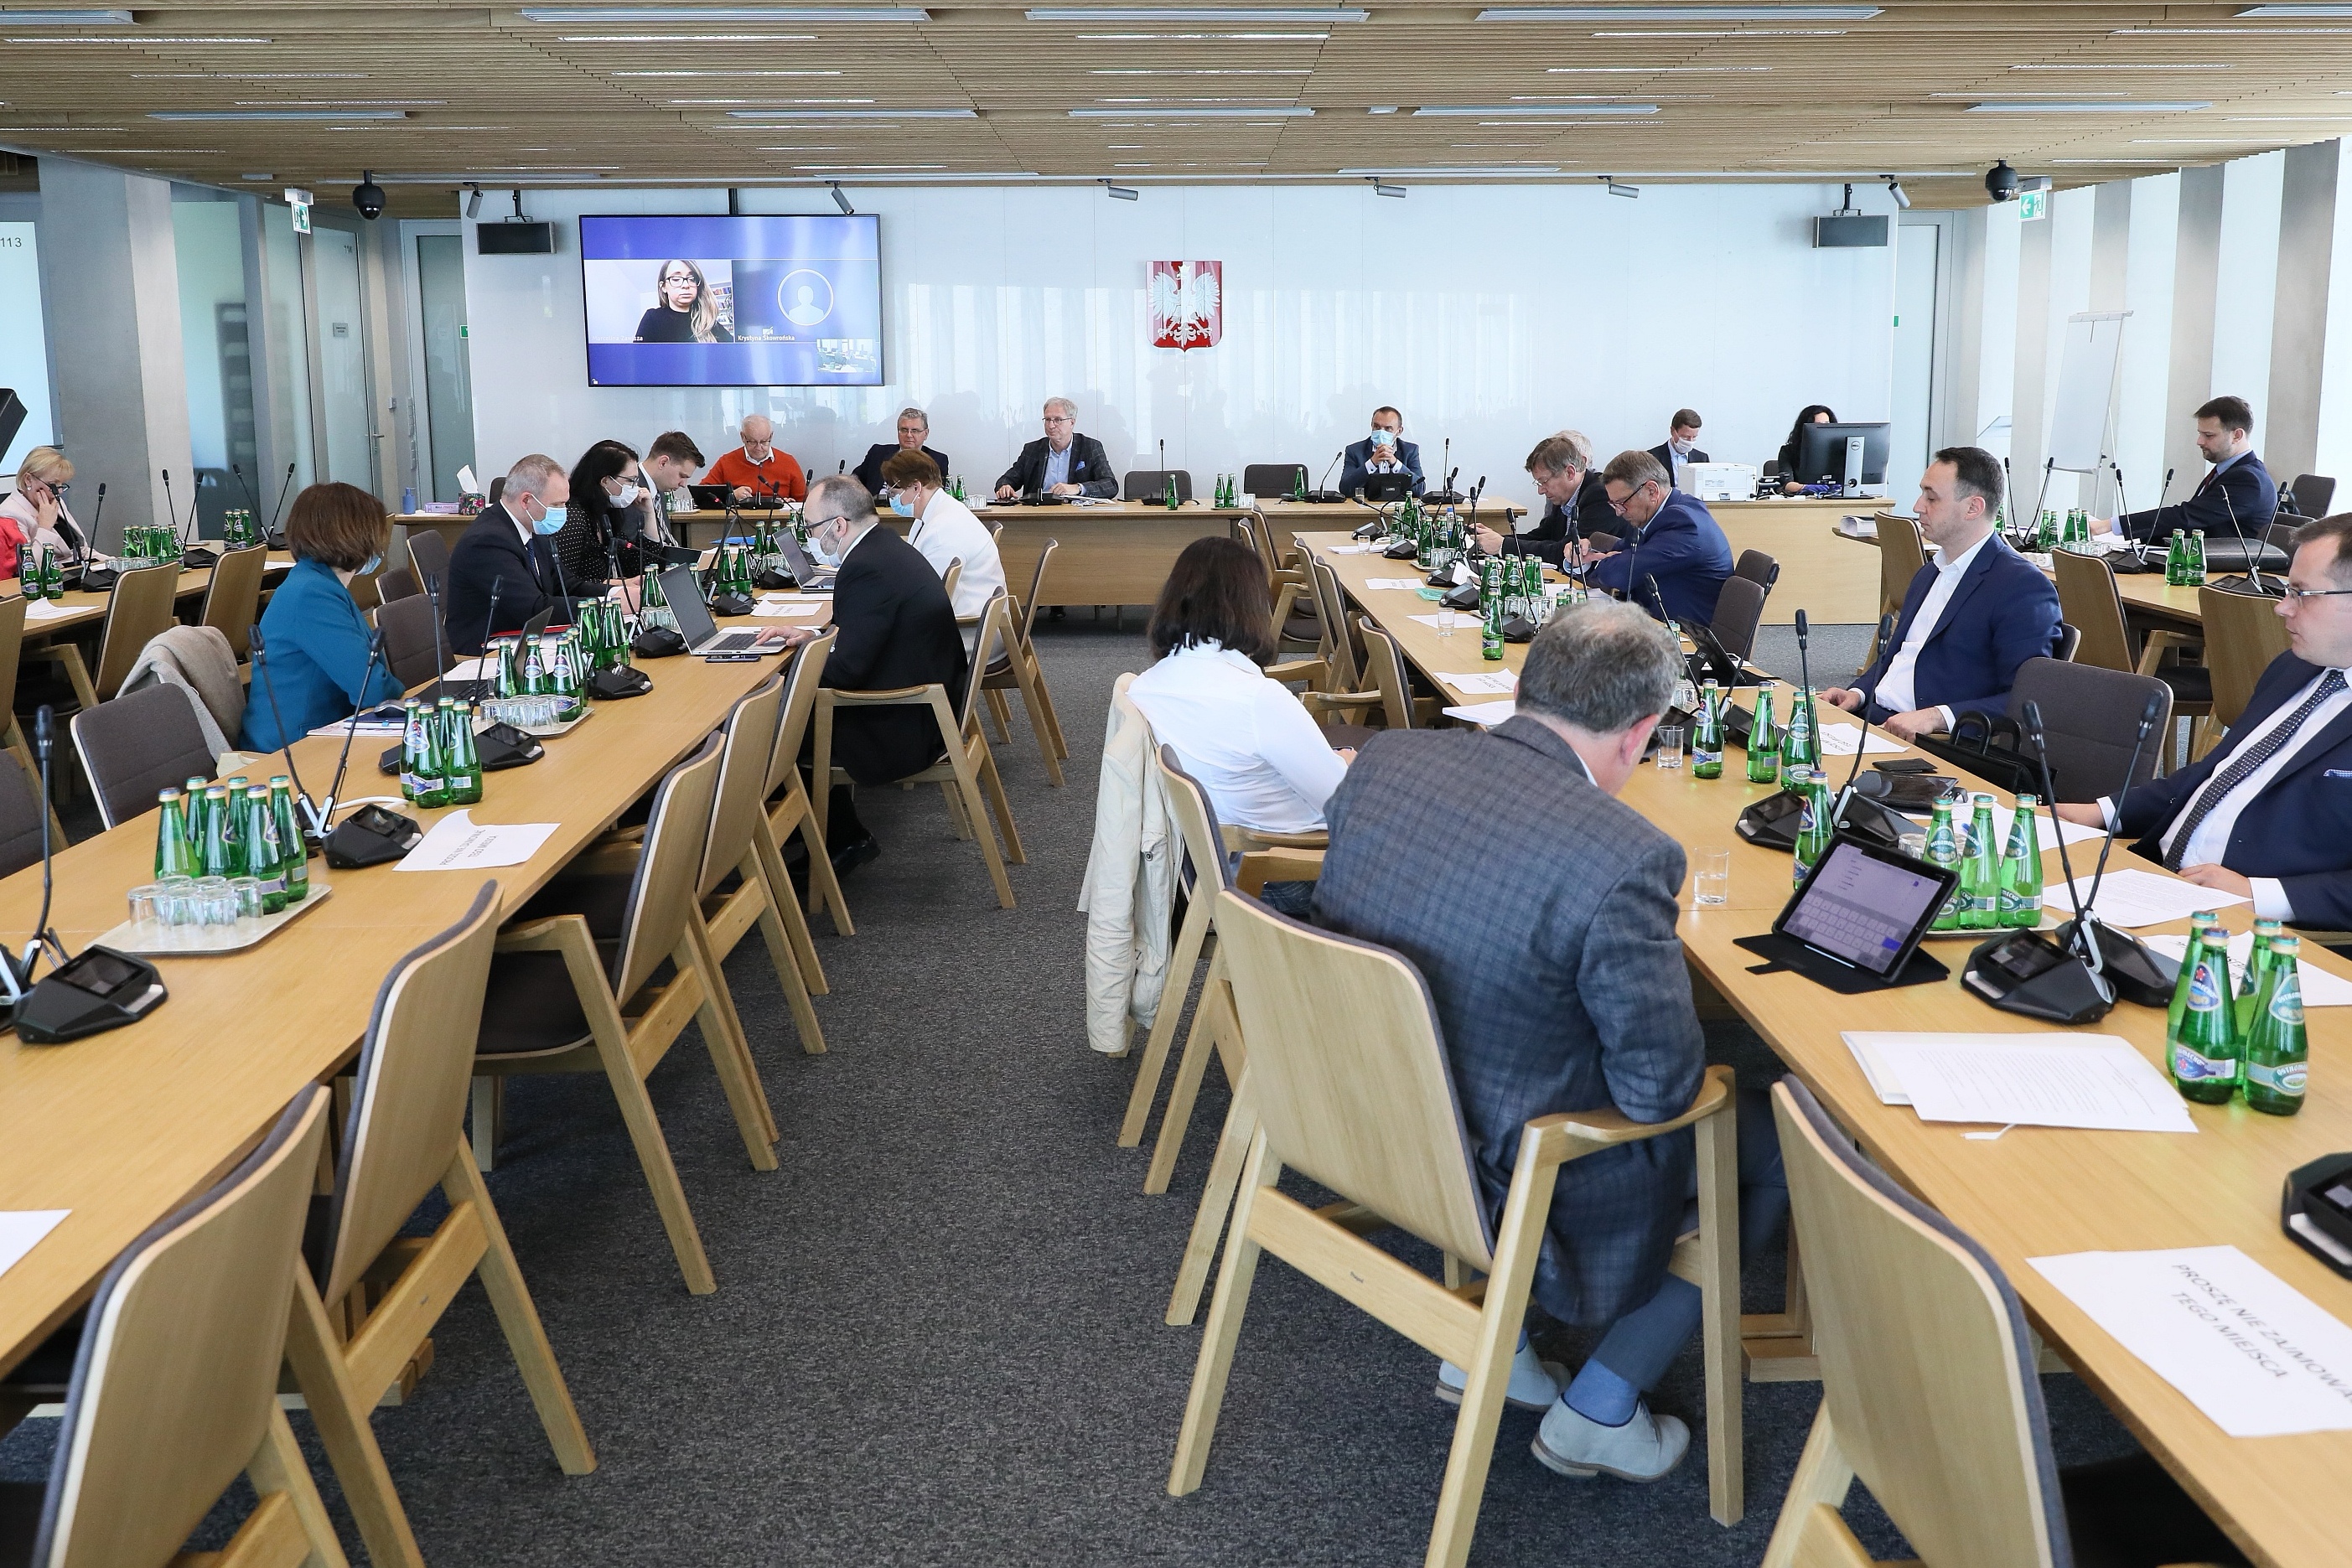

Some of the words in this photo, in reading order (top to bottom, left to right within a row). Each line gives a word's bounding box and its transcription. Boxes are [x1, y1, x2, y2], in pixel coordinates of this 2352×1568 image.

[0, 237, 22, 247] 113
[2172, 1264, 2238, 1306] PROSZĘ
[2230, 1307, 2267, 1328] NIE
[2259, 1329, 2352, 1406] ZAJMOWA
[2172, 1292, 2219, 1322] TEGO
[2213, 1324, 2288, 1378] MIEJSCA
